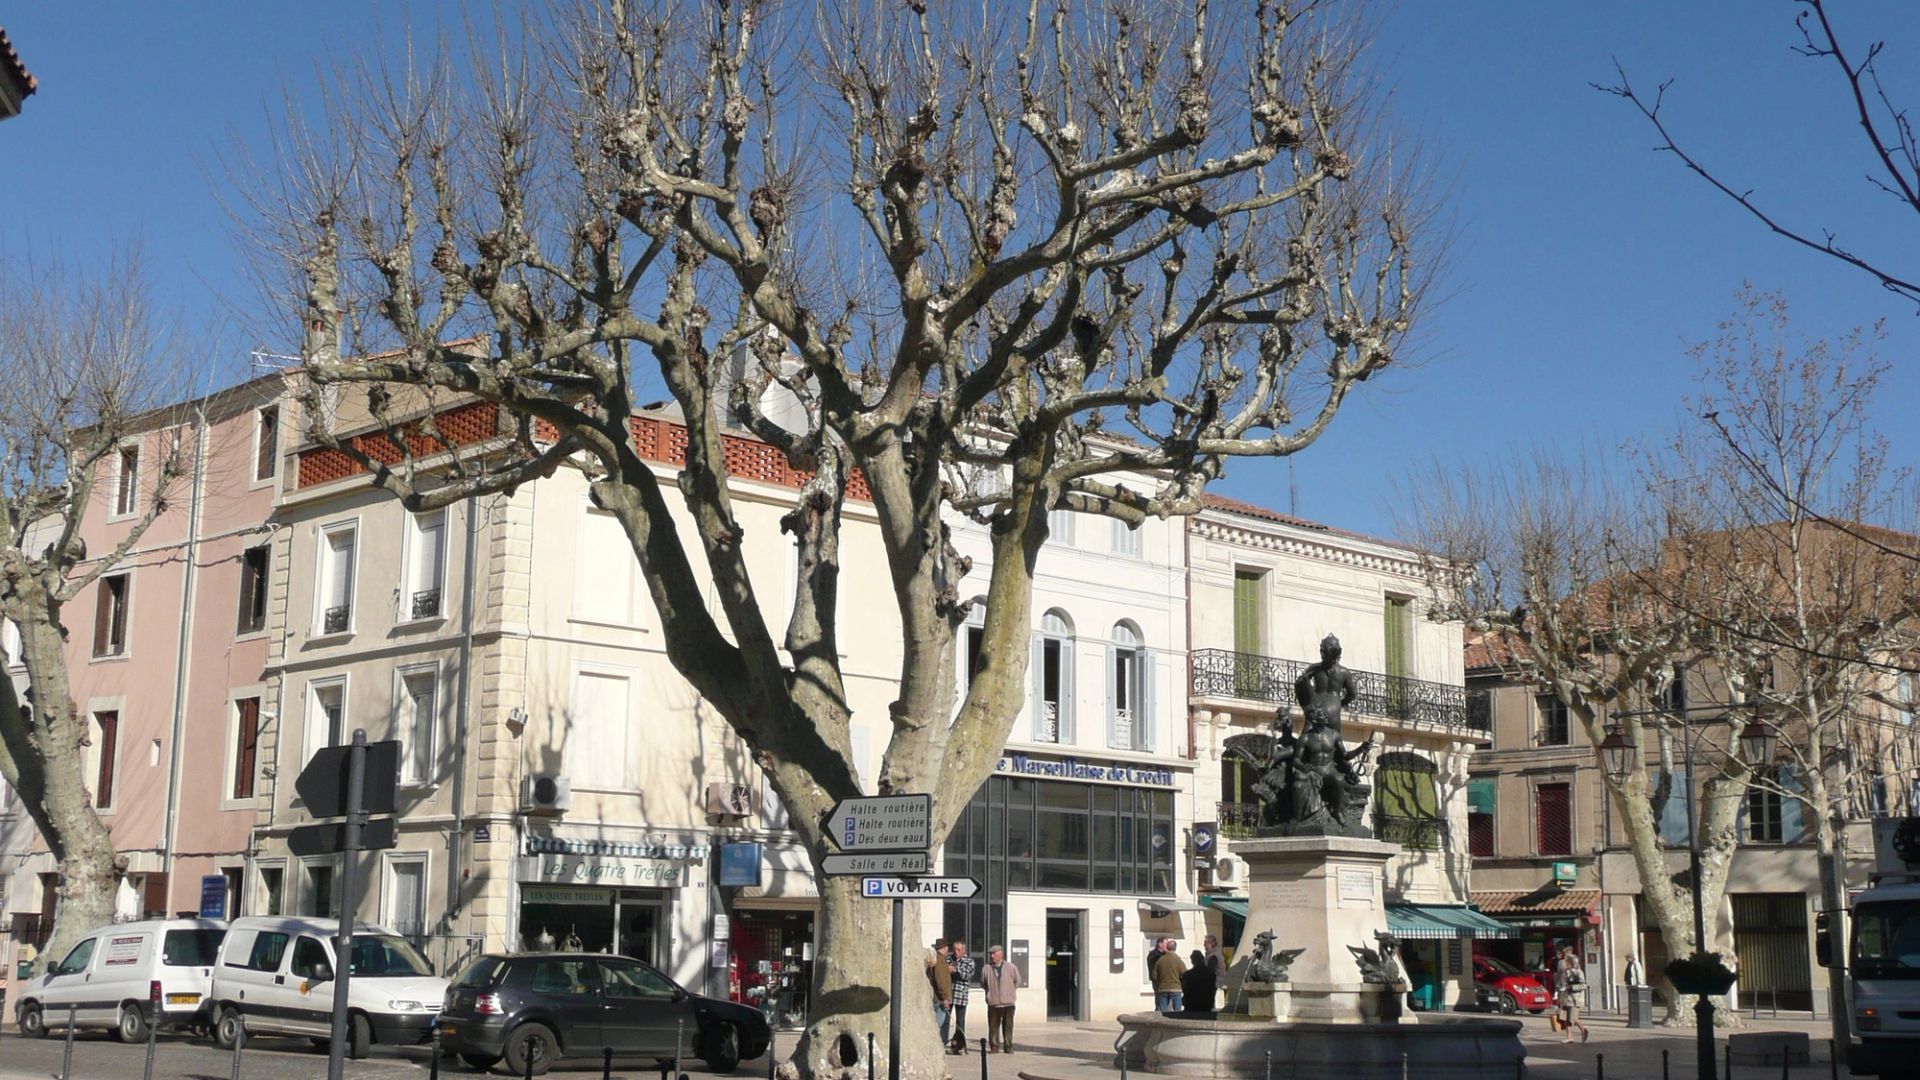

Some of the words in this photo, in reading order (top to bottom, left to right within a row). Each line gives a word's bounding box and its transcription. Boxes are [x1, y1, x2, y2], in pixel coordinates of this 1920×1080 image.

[1011, 754, 1105, 780] Marseillaise
[1106, 764, 1125, 781] de
[850, 804, 877, 814] Halte
[884, 802, 925, 814] routière
[859, 819, 883, 829] Halte
[888, 817, 925, 829] routière
[858, 834, 875, 844] Des
[878, 832, 899, 844] deux
[903, 833, 924, 843] eaux
[543, 859, 568, 876] Les
[575, 861, 626, 879] Quatre
[850, 858, 876, 870] Salle
[882, 858, 895, 869] du
[901, 856, 925, 869] Réal
[869, 881, 880, 893] P
[887, 882, 960, 893] VOLTAIRE
